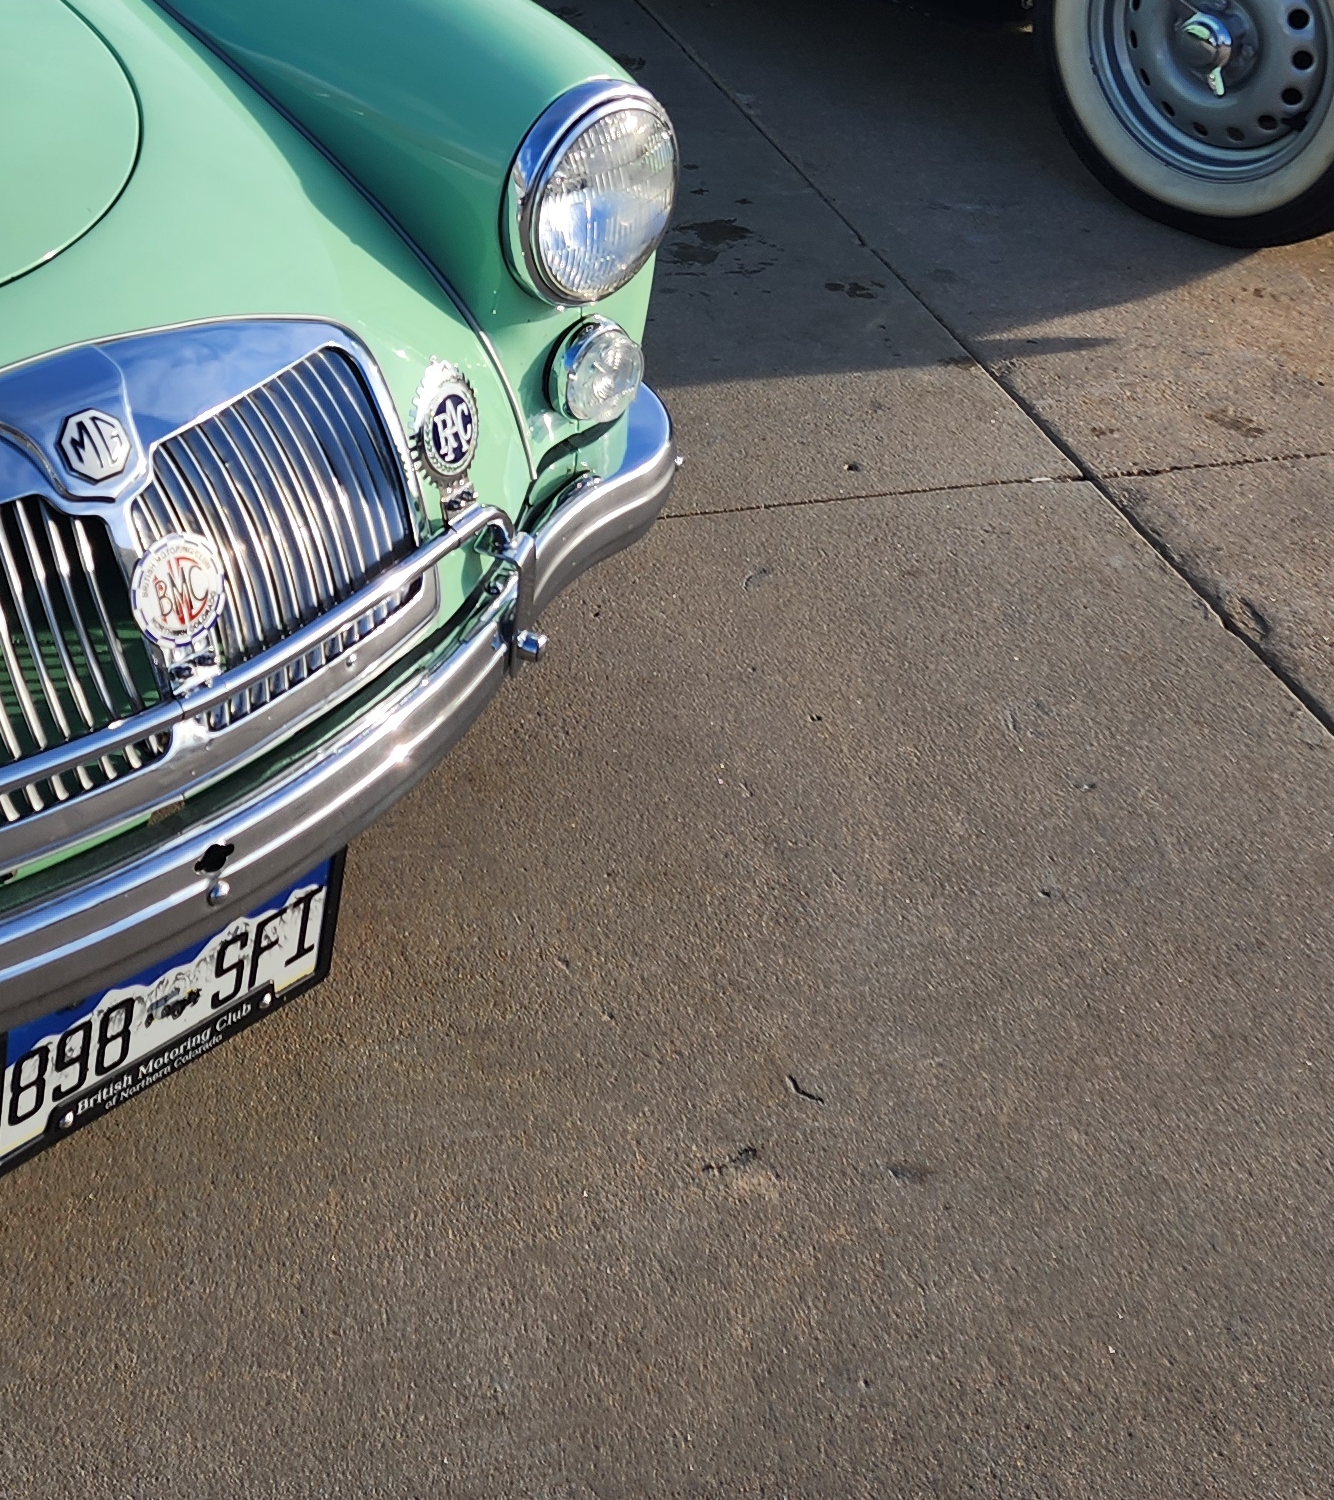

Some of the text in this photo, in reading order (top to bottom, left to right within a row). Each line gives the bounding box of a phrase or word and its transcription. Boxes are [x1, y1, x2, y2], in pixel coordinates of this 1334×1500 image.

[69, 415, 124, 469] MG
[433, 398, 473, 462] RAC
[142, 564, 156, 598] BRITISH
[156, 545, 193, 563] MOTORING
[155, 564, 209, 619] BMC
[152, 590, 217, 636] NORTHERN COLORADO
[7, 884, 324, 1127] 898 SFI
[76, 1002, 252, 1115] British Motoring Club
[105, 1033, 223, 1110] of Northern Colorado
